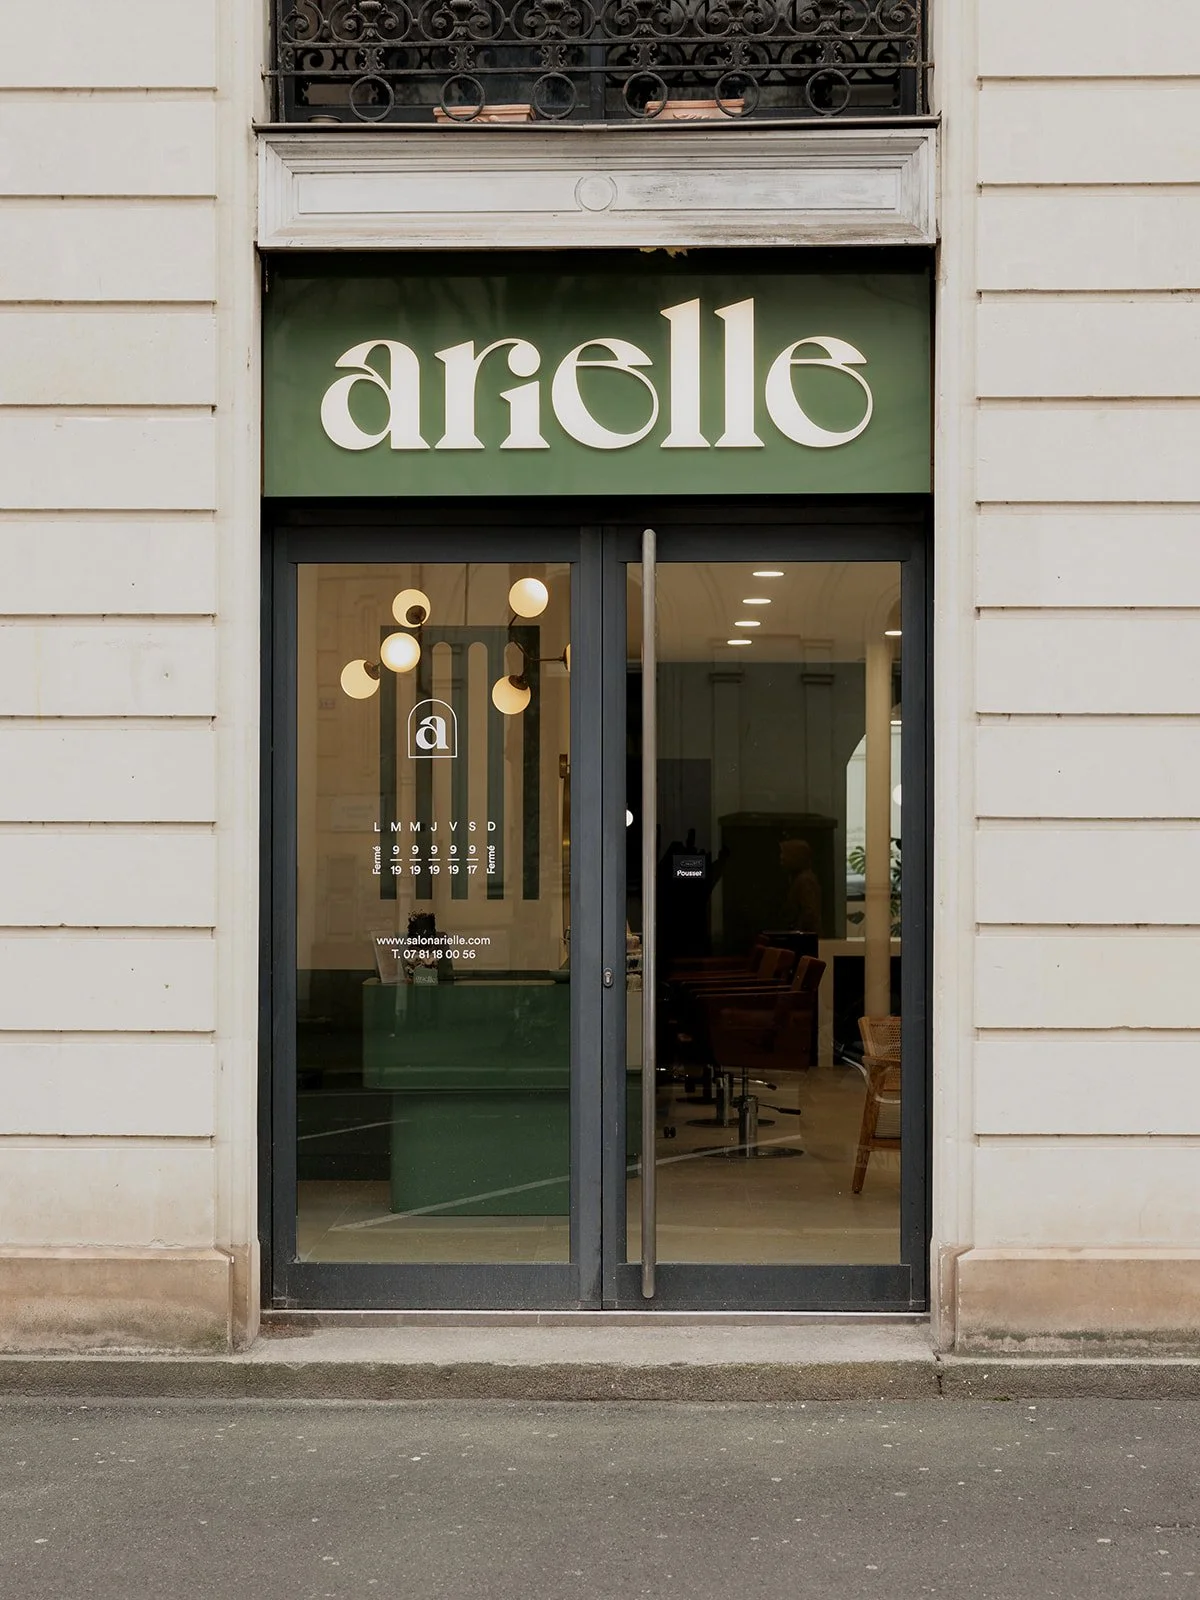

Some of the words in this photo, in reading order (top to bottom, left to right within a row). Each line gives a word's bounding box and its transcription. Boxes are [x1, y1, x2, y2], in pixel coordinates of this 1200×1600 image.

[320, 297, 874, 450] arielle
[415, 715, 450, 750] a
[373, 821, 381, 832] L
[390, 821, 402, 832] M
[409, 821, 421, 832] M
[430, 821, 438, 832] J
[448, 821, 458, 832] V
[468, 821, 477, 832] S
[487, 821, 496, 832] D
[392, 844, 400, 855] 9
[411, 844, 419, 855] 9
[430, 844, 438, 855] 9
[449, 844, 458, 855] 9
[468, 844, 477, 855] 9
[372, 845, 382, 875] Fermé
[486, 845, 496, 874] Fermé
[390, 865, 402, 875] 19
[409, 865, 421, 875] 19
[428, 865, 441, 875] 19
[447, 865, 460, 875] 19
[466, 865, 478, 875] 17
[676, 869, 703, 877] Pousser
[376, 935, 491, 946] www.salonarielle.com
[391, 949, 401, 959] T.
[403, 949, 417, 959] 07
[418, 949, 429, 959] 81
[432, 949, 443, 959] 18
[445, 949, 460, 959] 00
[462, 949, 476, 959] 56
